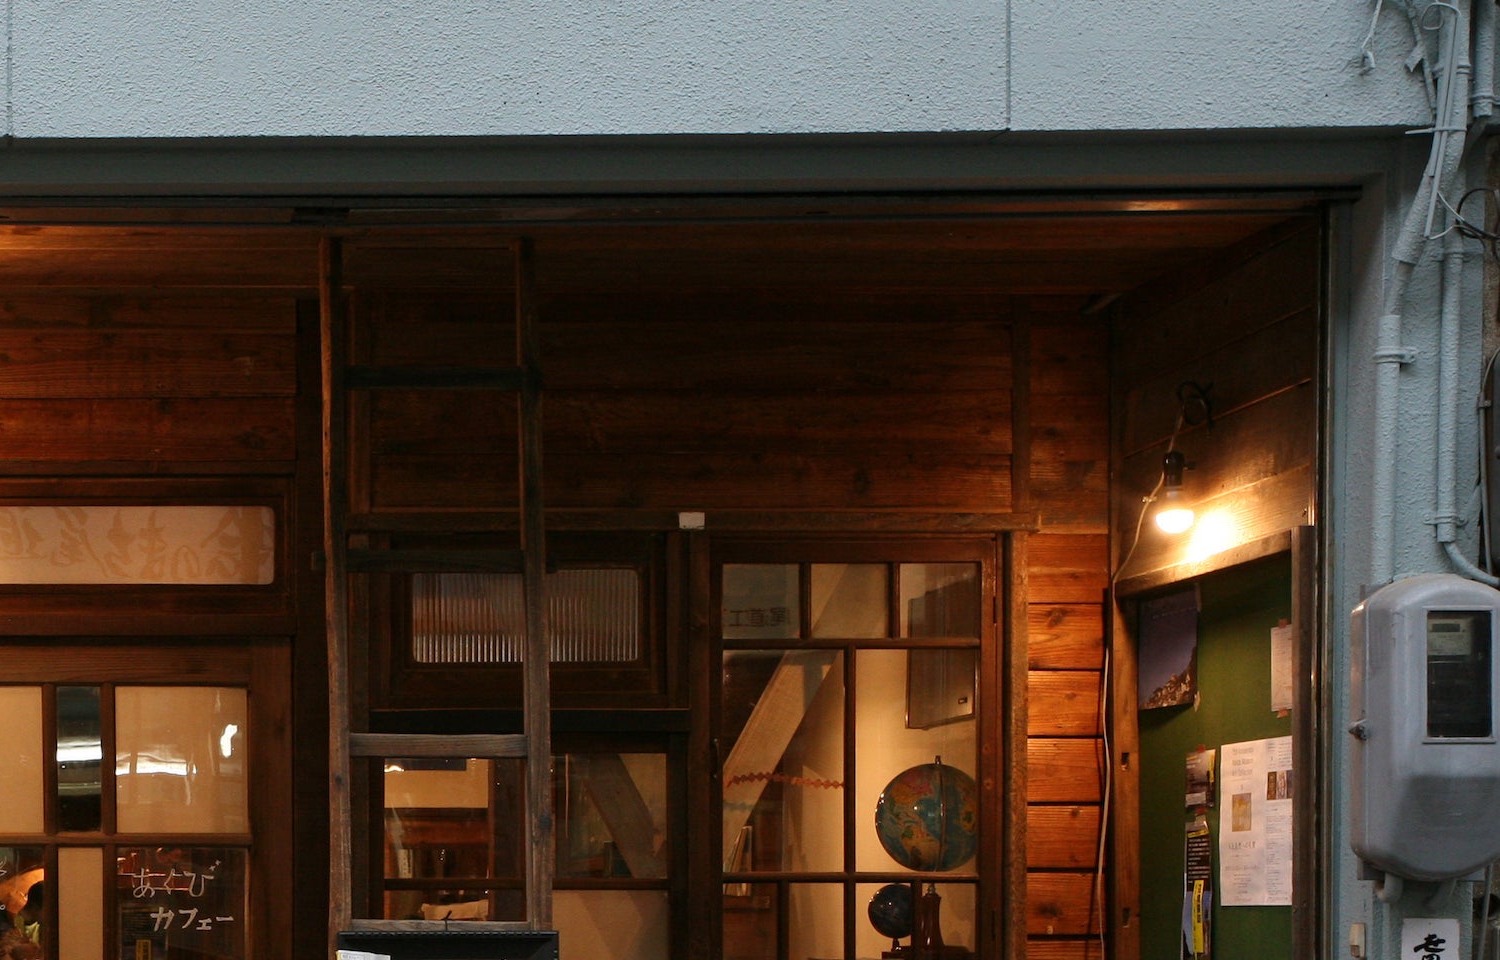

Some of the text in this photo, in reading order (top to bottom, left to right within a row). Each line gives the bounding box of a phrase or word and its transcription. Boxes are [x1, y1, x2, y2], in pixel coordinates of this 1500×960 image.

[132, 860, 221, 898] あくび
[149, 906, 235, 932] カフェー
